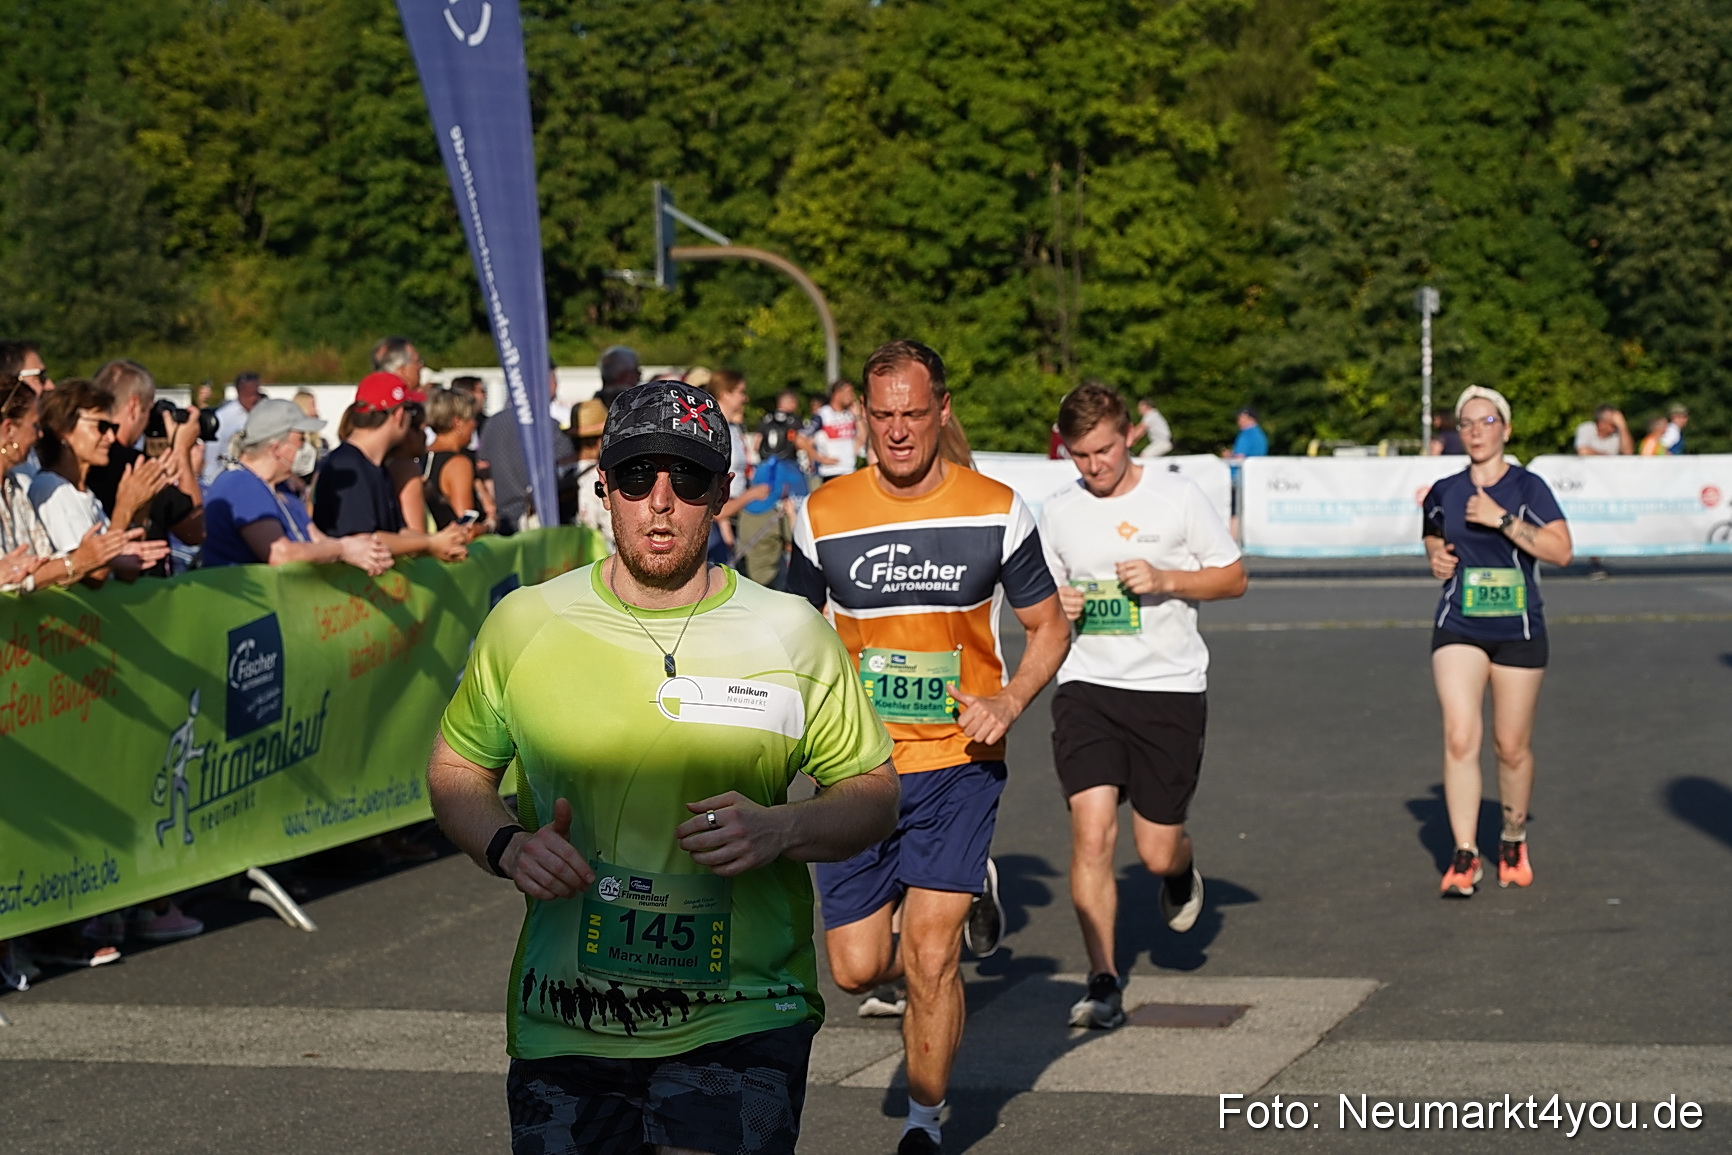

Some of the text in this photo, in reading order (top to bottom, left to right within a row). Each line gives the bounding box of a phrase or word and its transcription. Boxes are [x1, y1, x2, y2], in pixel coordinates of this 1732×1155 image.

[871, 559, 968, 584] Fischer
[881, 581, 960, 594] AUTOMOBILE
[1478, 586, 1511, 602] 953
[1086, 598, 1121, 617] 200
[236, 652, 278, 684] Fischer
[728, 685, 768, 698] Klinikum
[876, 674, 944, 701] 1819
[727, 695, 767, 707] Neumarkt
[874, 699, 943, 711] Koehler Stefan
[201, 690, 331, 804] firmenlauf
[621, 890, 670, 902] Firmenlauf
[585, 914, 602, 954] RUN
[619, 909, 696, 951] 145
[709, 920, 724, 973] 2022
[608, 946, 698, 968] Marx Manuel
[741, 1074, 776, 1093] Reebok
